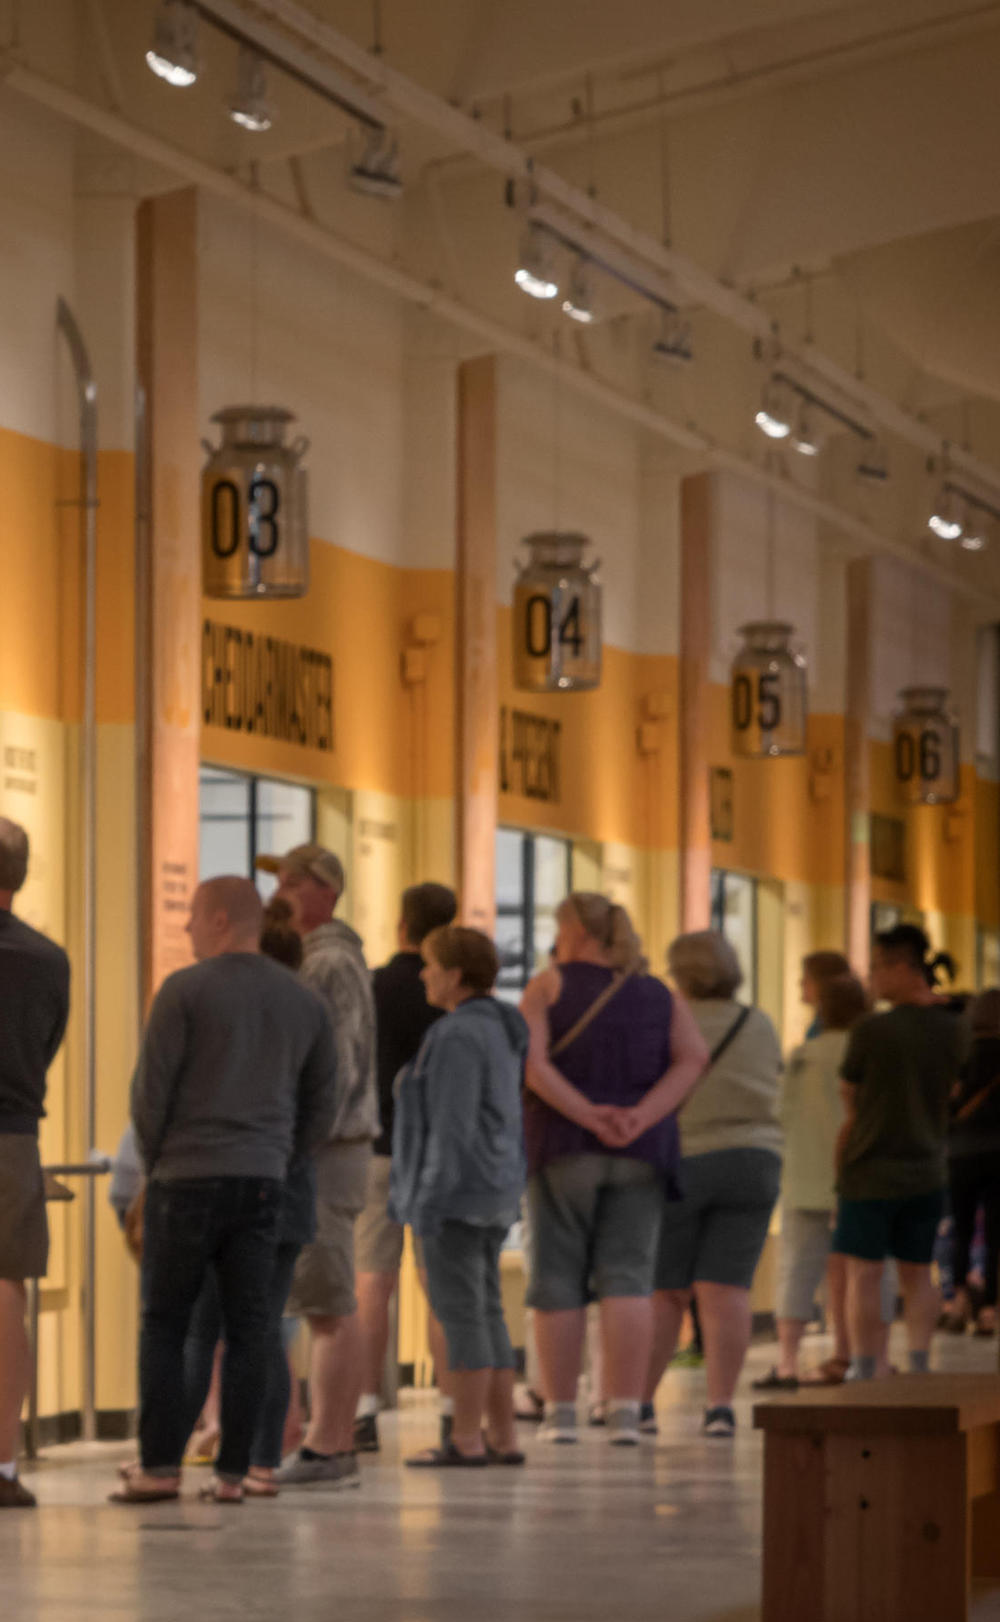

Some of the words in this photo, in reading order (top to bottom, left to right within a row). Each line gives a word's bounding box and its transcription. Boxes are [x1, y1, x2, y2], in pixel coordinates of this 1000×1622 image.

[210, 479, 281, 560] 03
[525, 594, 584, 659] 04
[733, 673, 782, 732] 05
[895, 729, 942, 783] 06
